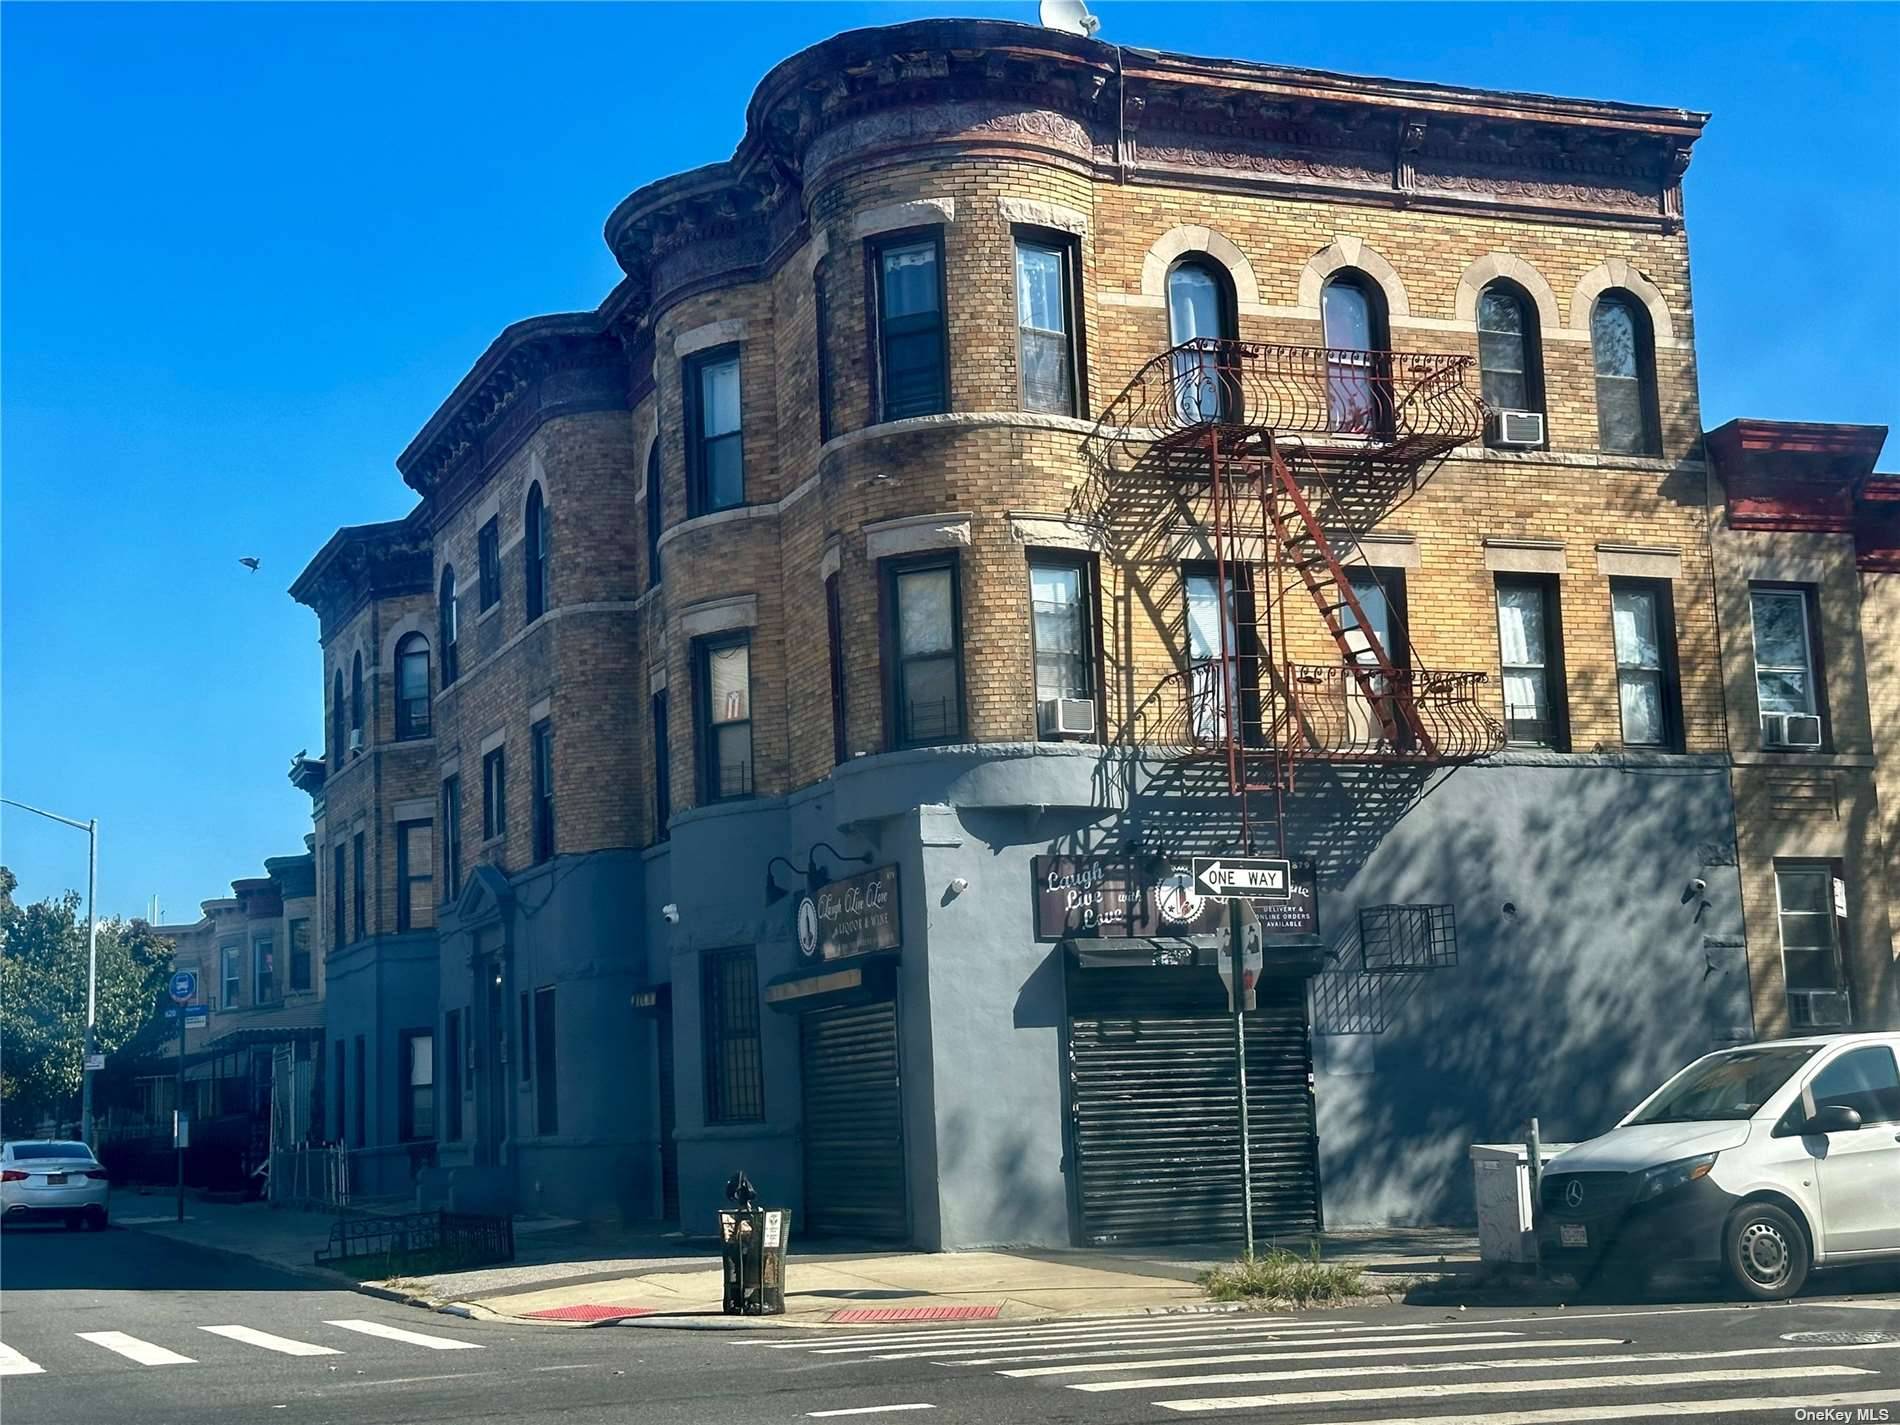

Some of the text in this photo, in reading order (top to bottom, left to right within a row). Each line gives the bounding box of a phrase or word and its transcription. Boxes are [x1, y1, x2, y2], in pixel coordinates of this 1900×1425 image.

[1046, 861, 1104, 893] Laugh
[1209, 870, 1277, 886] ONE WAY
[844, 887, 863, 915] Live
[866, 881, 888, 910] Love
[1065, 889, 1142, 911] Live with
[1082, 908, 1122, 930] Love
